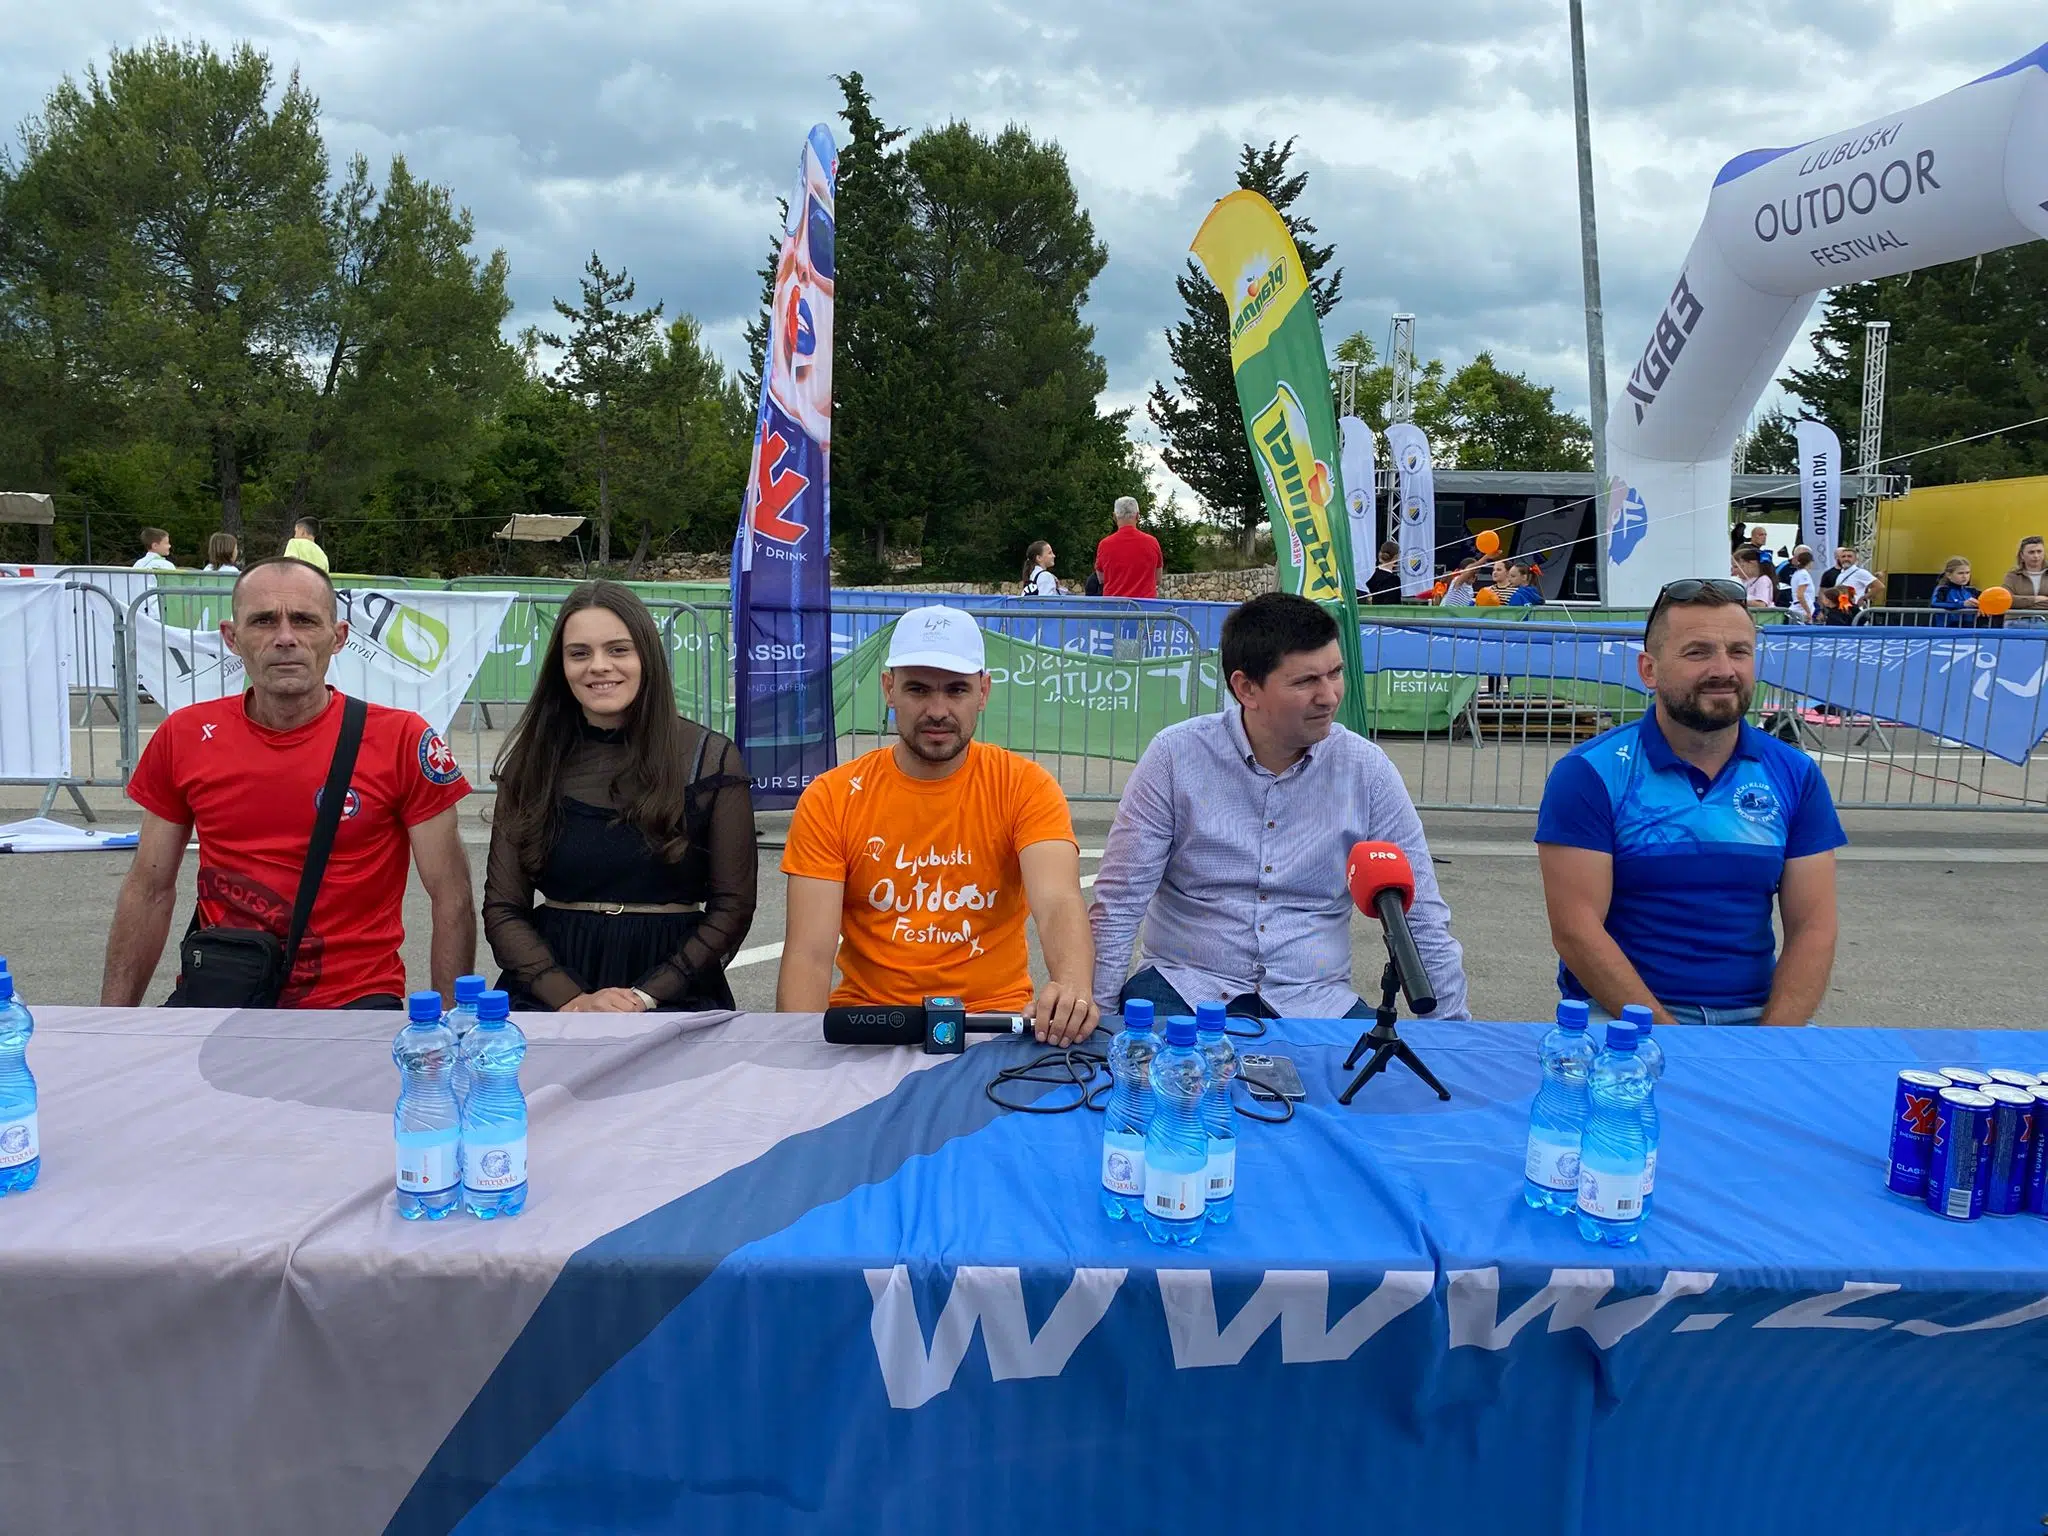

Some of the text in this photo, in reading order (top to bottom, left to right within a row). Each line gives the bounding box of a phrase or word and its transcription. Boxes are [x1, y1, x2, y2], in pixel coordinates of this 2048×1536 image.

[1799, 122, 1903, 176] LJUBUŠKI
[1755, 149, 1941, 242] OUTDOOR
[1811, 229, 1909, 267] FESTIVAL
[766, 546, 808, 562] DRINK
[1393, 671, 1449, 683] FESTIVAL
[895, 843, 972, 876] Ljubuški
[1369, 851, 1398, 860] PRO
[868, 875, 998, 913] Outdoor
[891, 916, 972, 944] Festival
[847, 1014, 887, 1025] BOYA
